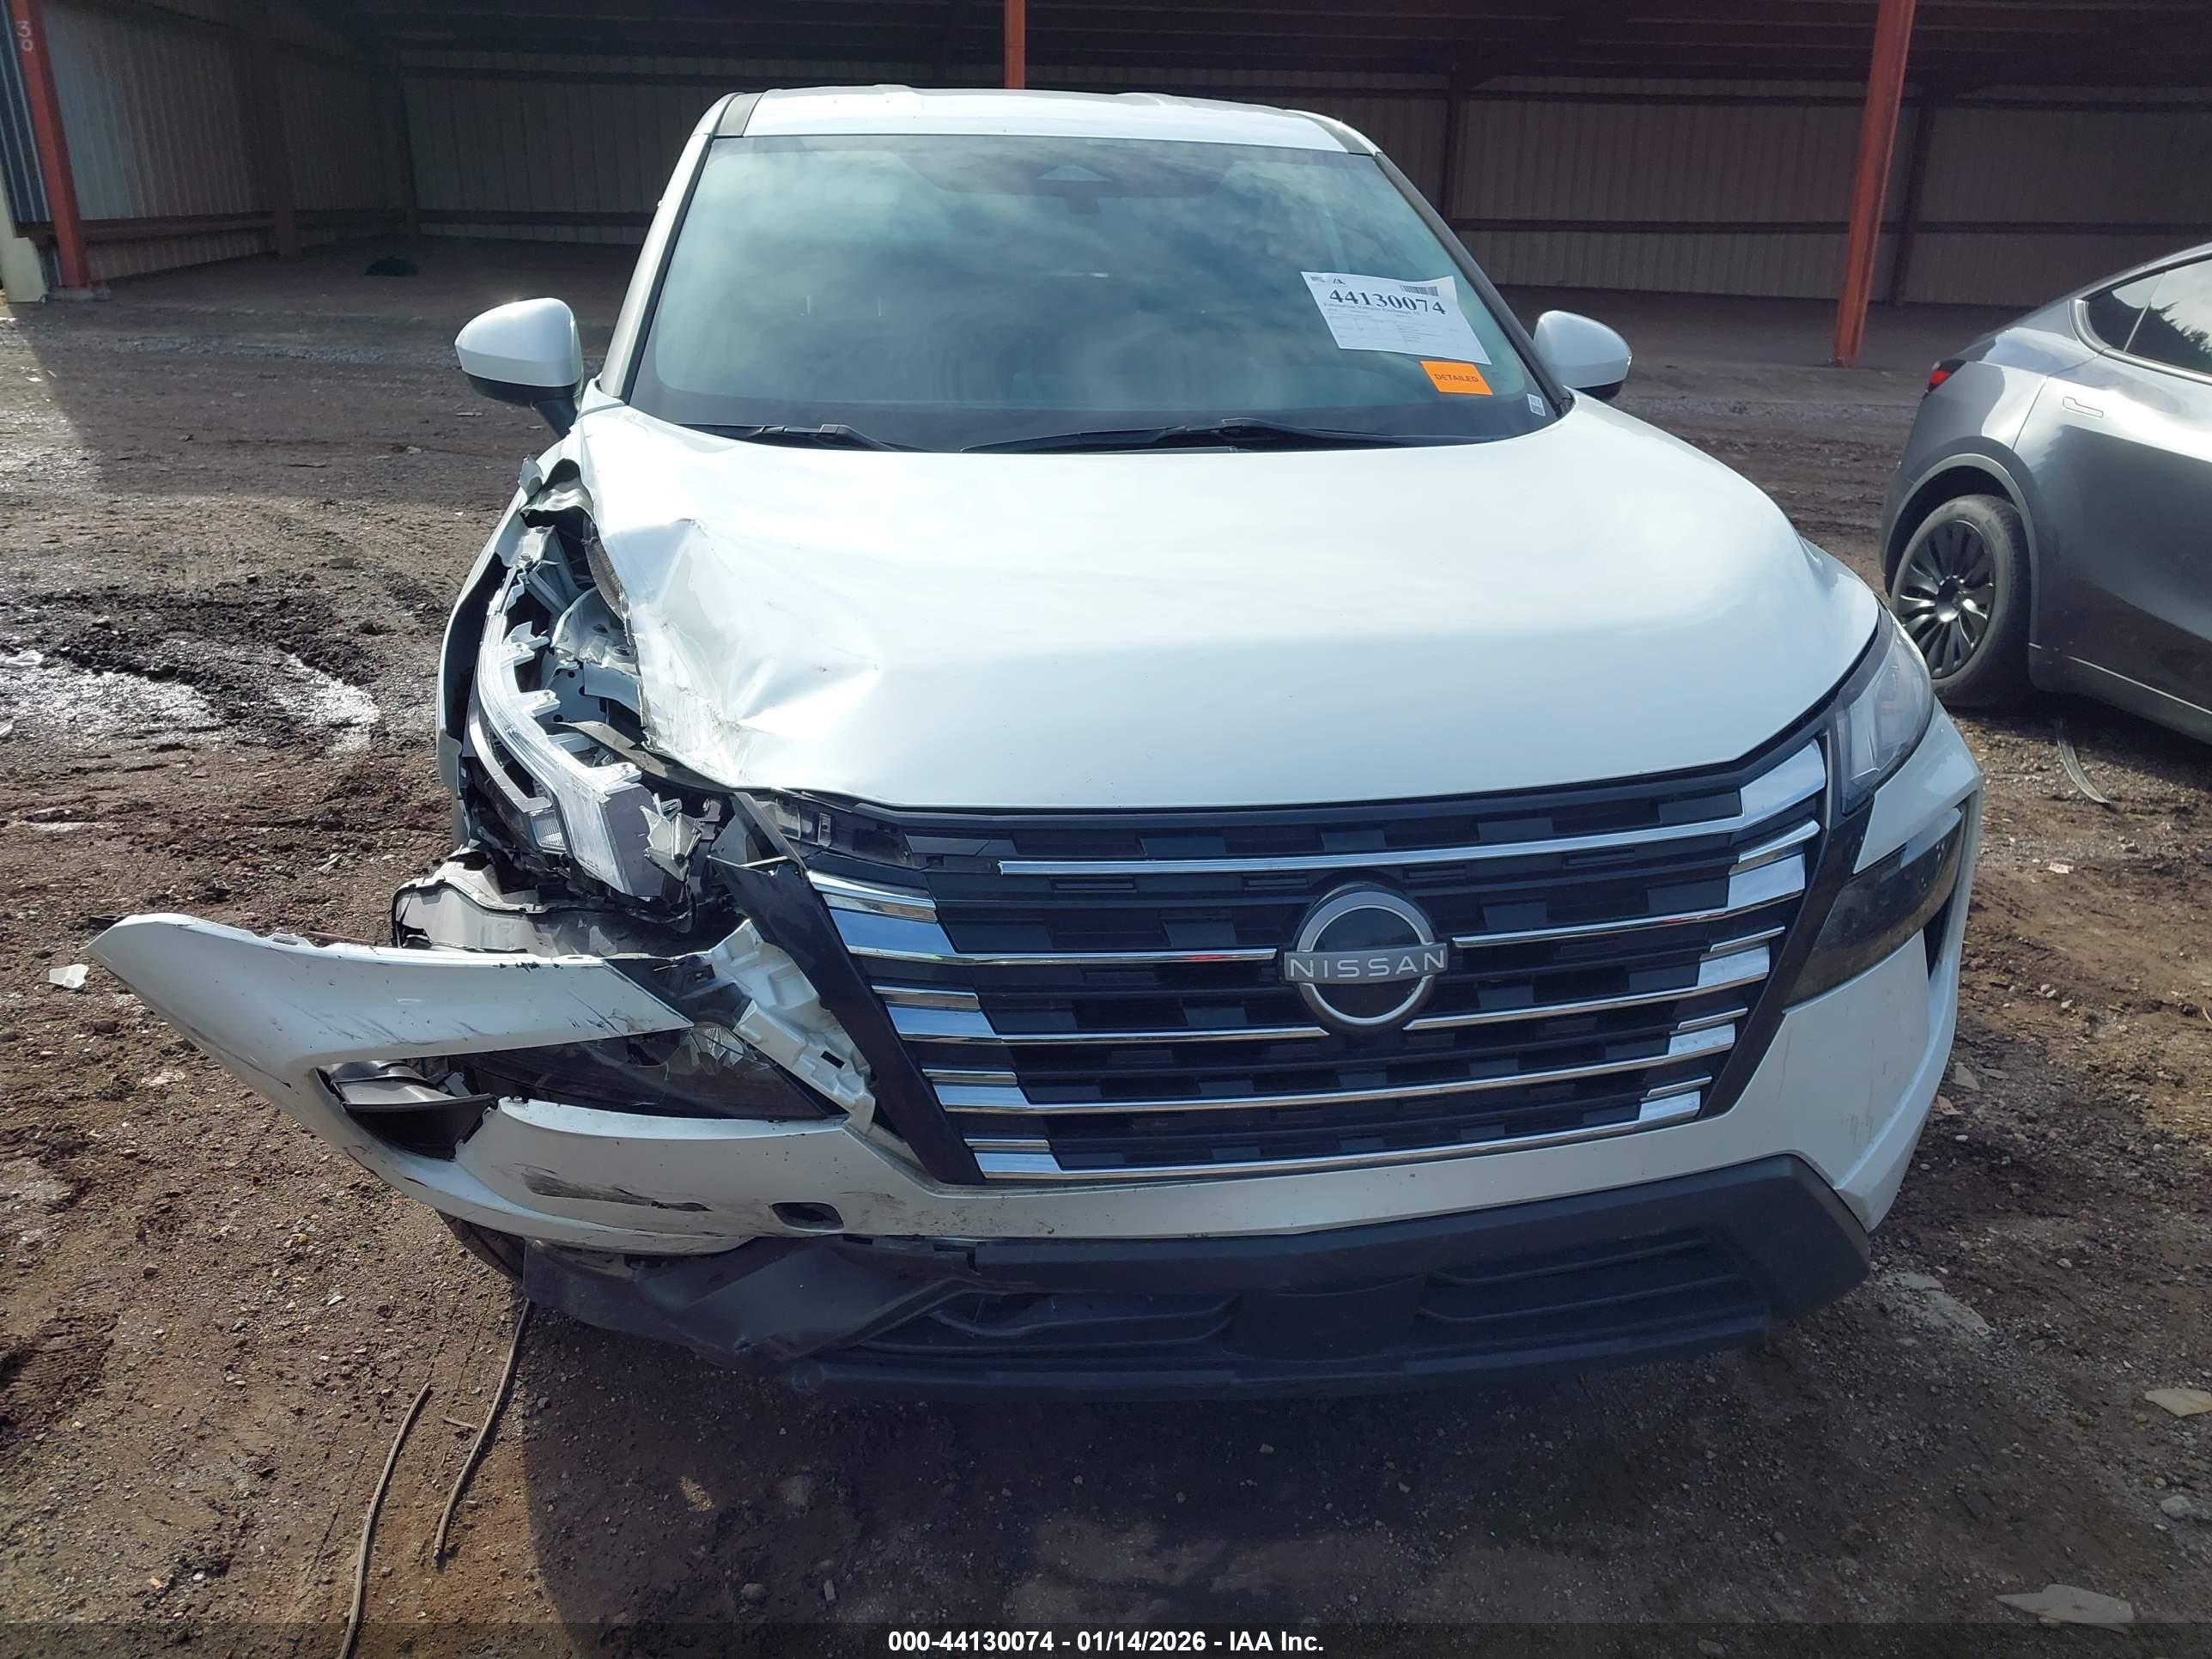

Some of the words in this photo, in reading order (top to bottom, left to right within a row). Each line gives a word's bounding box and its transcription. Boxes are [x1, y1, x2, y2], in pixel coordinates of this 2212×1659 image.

[1329, 289, 1446, 315] 44130074
[1434, 374, 1479, 383] DETAILED
[1289, 949, 1445, 979] NISSAN
